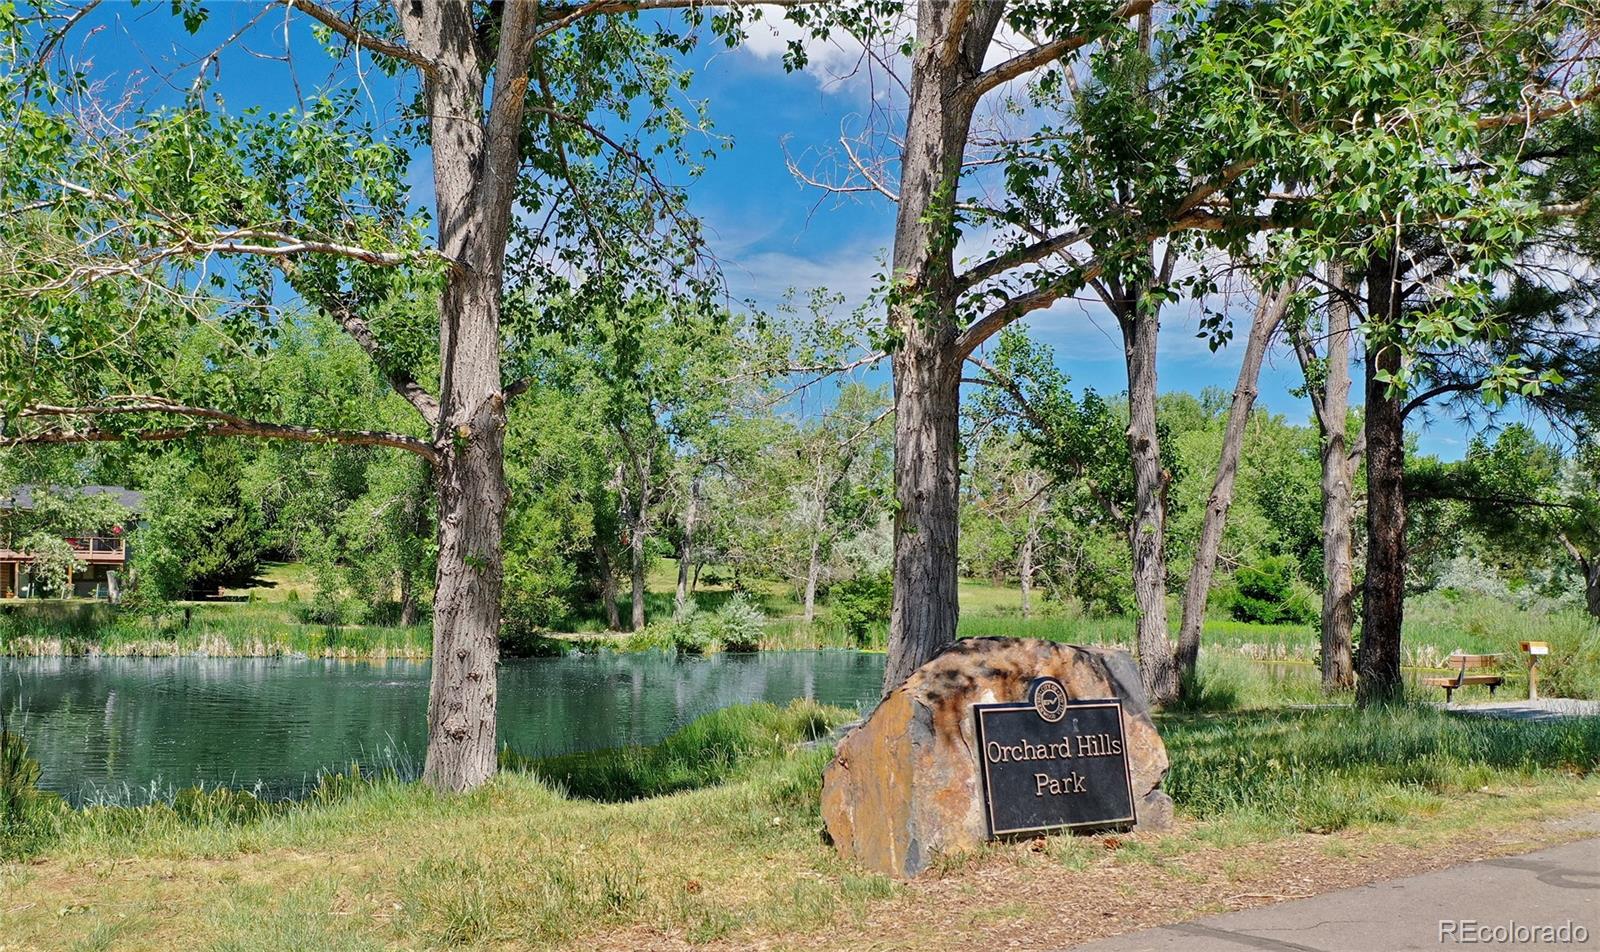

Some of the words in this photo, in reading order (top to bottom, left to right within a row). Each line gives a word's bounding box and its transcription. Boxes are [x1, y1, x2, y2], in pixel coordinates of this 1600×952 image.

[987, 736, 1072, 764] Orchard
[1076, 733, 1122, 757] Hills
[1034, 771, 1087, 796] Park
